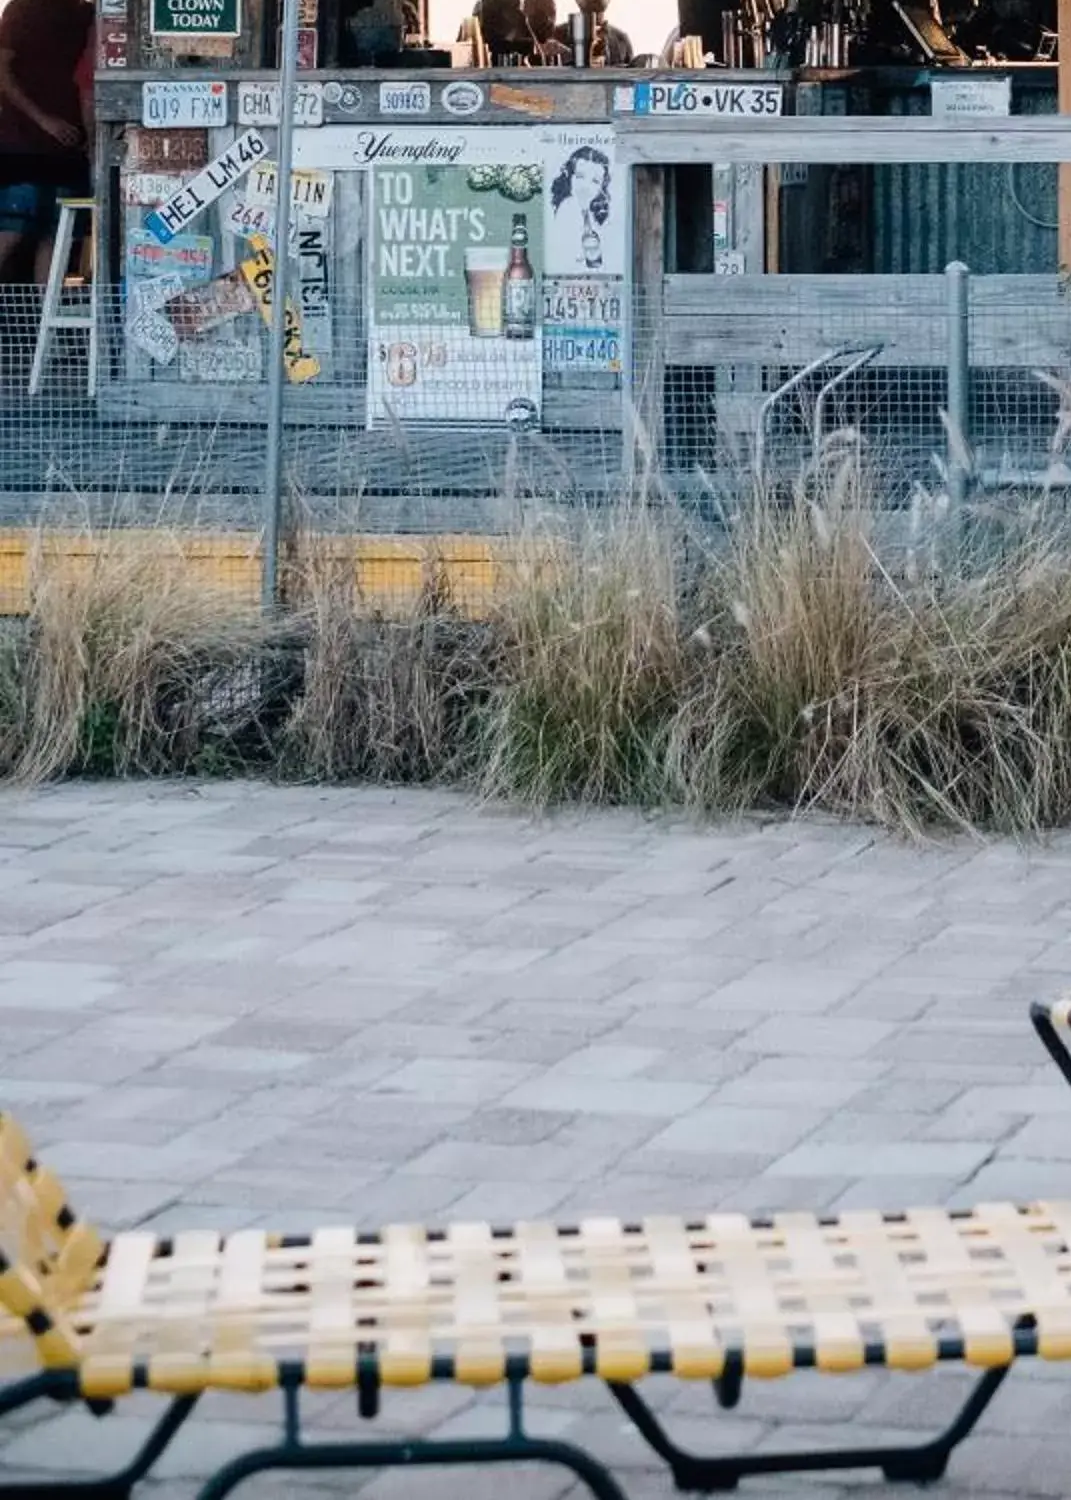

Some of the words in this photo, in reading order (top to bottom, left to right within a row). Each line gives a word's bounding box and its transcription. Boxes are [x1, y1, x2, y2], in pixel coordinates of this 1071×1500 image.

[171, 14, 221, 29] TODAY
[191, 97, 223, 120] FXM
[750, 89, 780, 114] 35
[238, 134, 266, 163] 46
[353, 131, 467, 164] Yuengling
[378, 172, 413, 205] TO
[378, 206, 486, 242] WHAT'S
[379, 244, 456, 277] NEXT.
